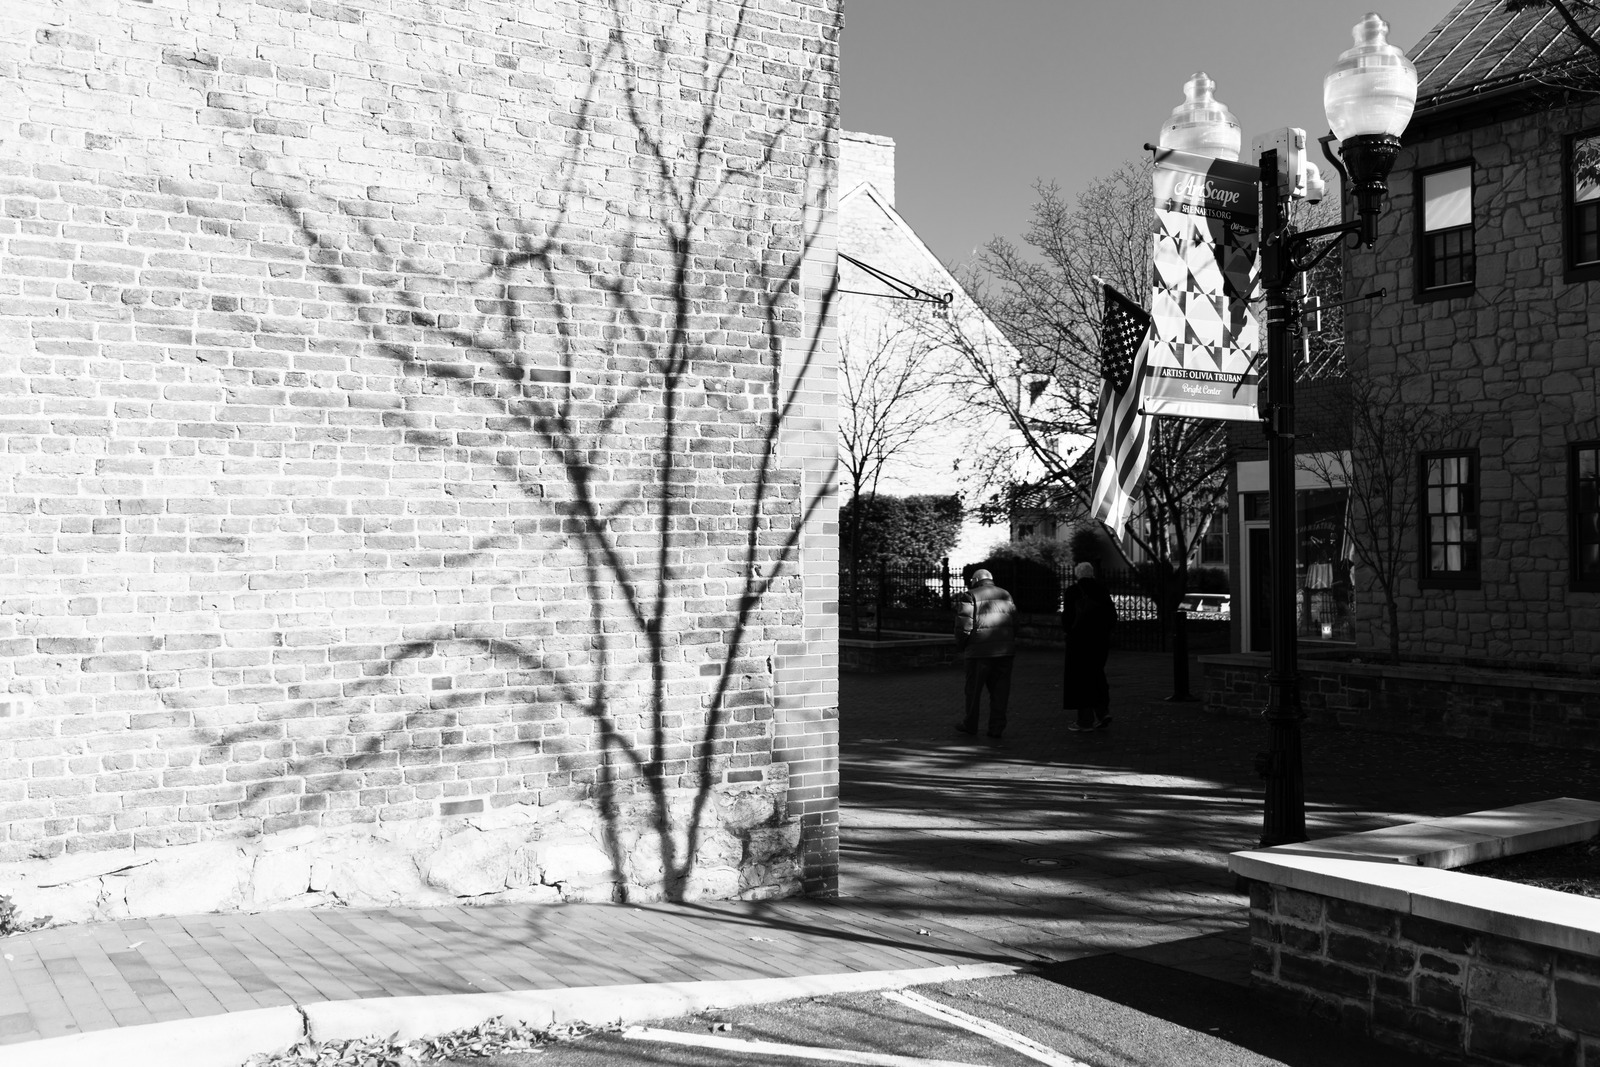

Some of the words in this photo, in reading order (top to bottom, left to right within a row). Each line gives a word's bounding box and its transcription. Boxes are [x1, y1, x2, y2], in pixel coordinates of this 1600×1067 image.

[1174, 175, 1240, 207] ArtScape
[1181, 203, 1232, 220] SHENARTS.ORG
[1162, 368, 1188, 378] ARTIST:
[1189, 371, 1213, 381] OLIVIA
[1214, 373, 1242, 383] TRUBAN
[1182, 383, 1202, 396] Bright
[1202, 385, 1222, 396] Center
